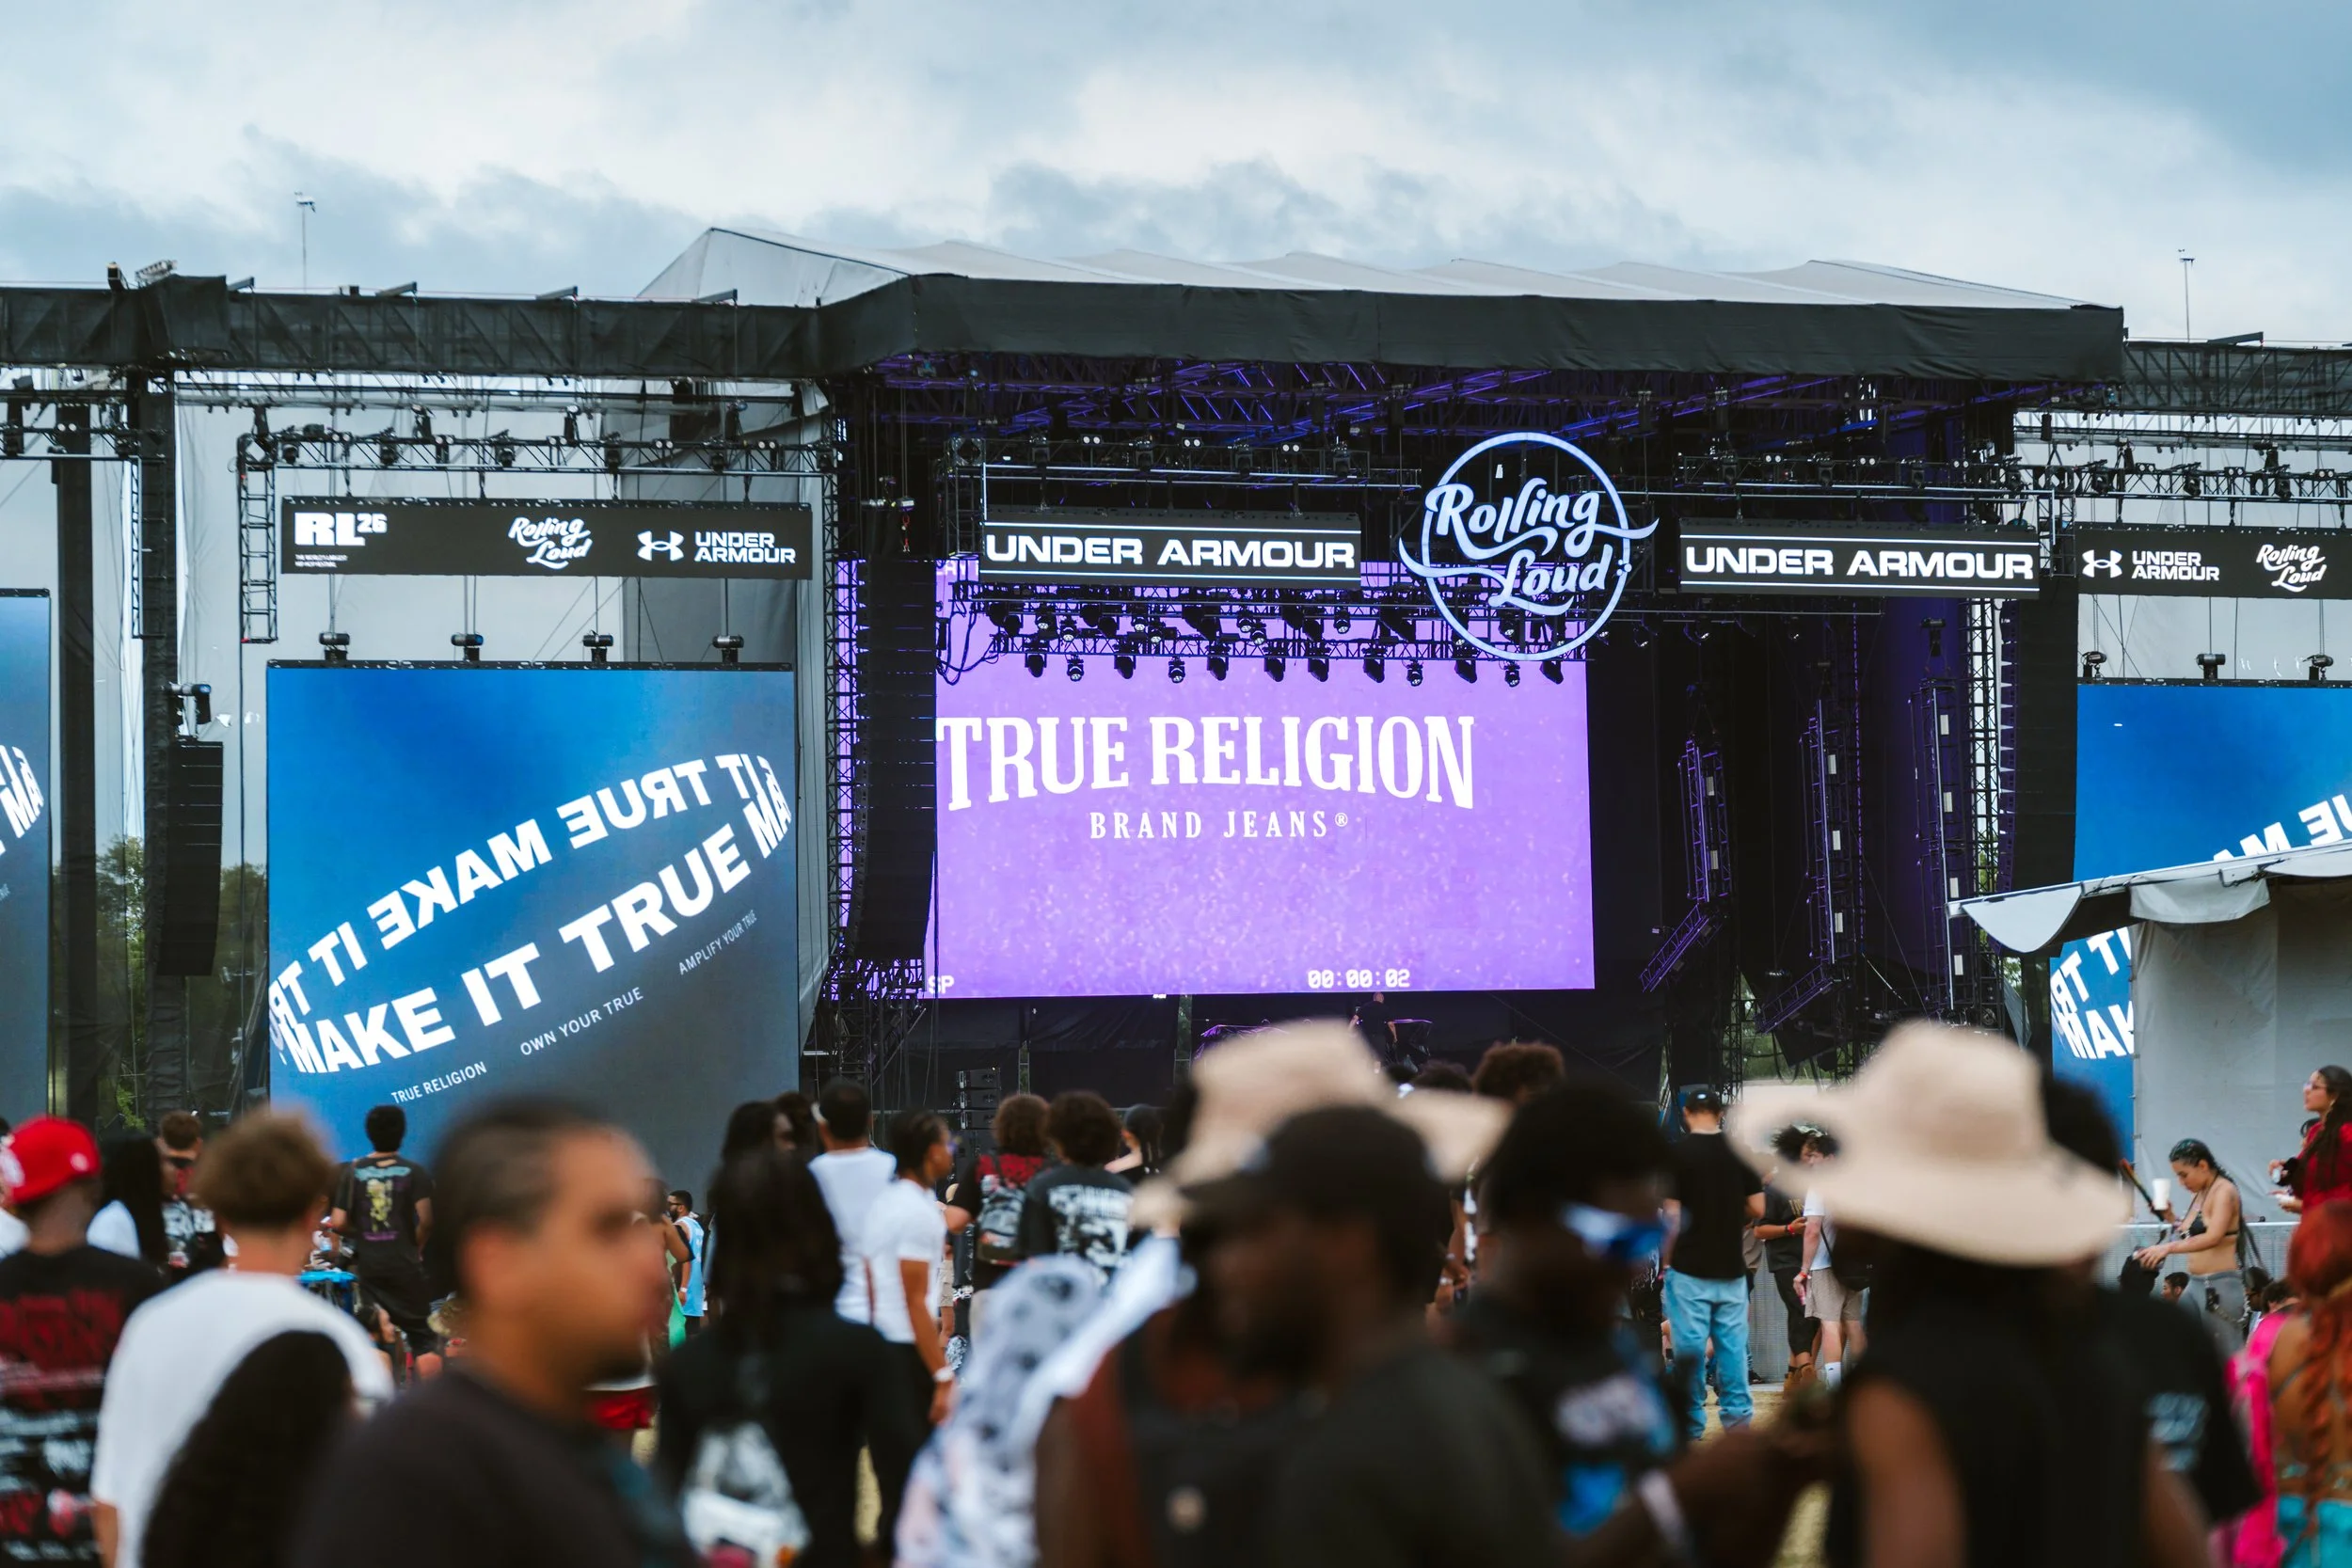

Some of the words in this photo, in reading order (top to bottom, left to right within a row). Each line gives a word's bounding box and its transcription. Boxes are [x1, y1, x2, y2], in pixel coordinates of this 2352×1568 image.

[508, 516, 591, 546] Rolling
[1424, 477, 1660, 560] Rolling
[526, 538, 593, 569] Loud
[693, 546, 796, 563] ARMOUR
[695, 531, 775, 547] UNDER
[986, 534, 1143, 564] UNDER
[1156, 539, 1355, 569] ARMOUR
[1686, 546, 1834, 576] UNDER
[1846, 549, 2034, 580] ARMOUR
[2131, 564, 2220, 581] ARMOUR
[2132, 550, 2201, 566] UNDER
[2256, 544, 2326, 571] Rolling
[1439, 539, 1613, 616] Loud
[2271, 564, 2328, 593] Loud
[936, 717, 1129, 811] TRUE
[1150, 716, 1474, 809] RELIGION
[1089, 812, 1201, 839] BRAND
[279, 987, 455, 1073] MAKE
[462, 942, 541, 1026] IT
[559, 823, 751, 973] TRUE
[678, 938, 723, 975] AMPLIFY
[722, 922, 745, 945] YOUR
[520, 1030, 557, 1055] OWN
[558, 1002, 602, 1037] YOUR
[602, 987, 644, 1016] TRUE
[2057, 1000, 2135, 1059] MAK
[390, 1085, 423, 1103] TRUE
[422, 1061, 487, 1095] RELIGION
